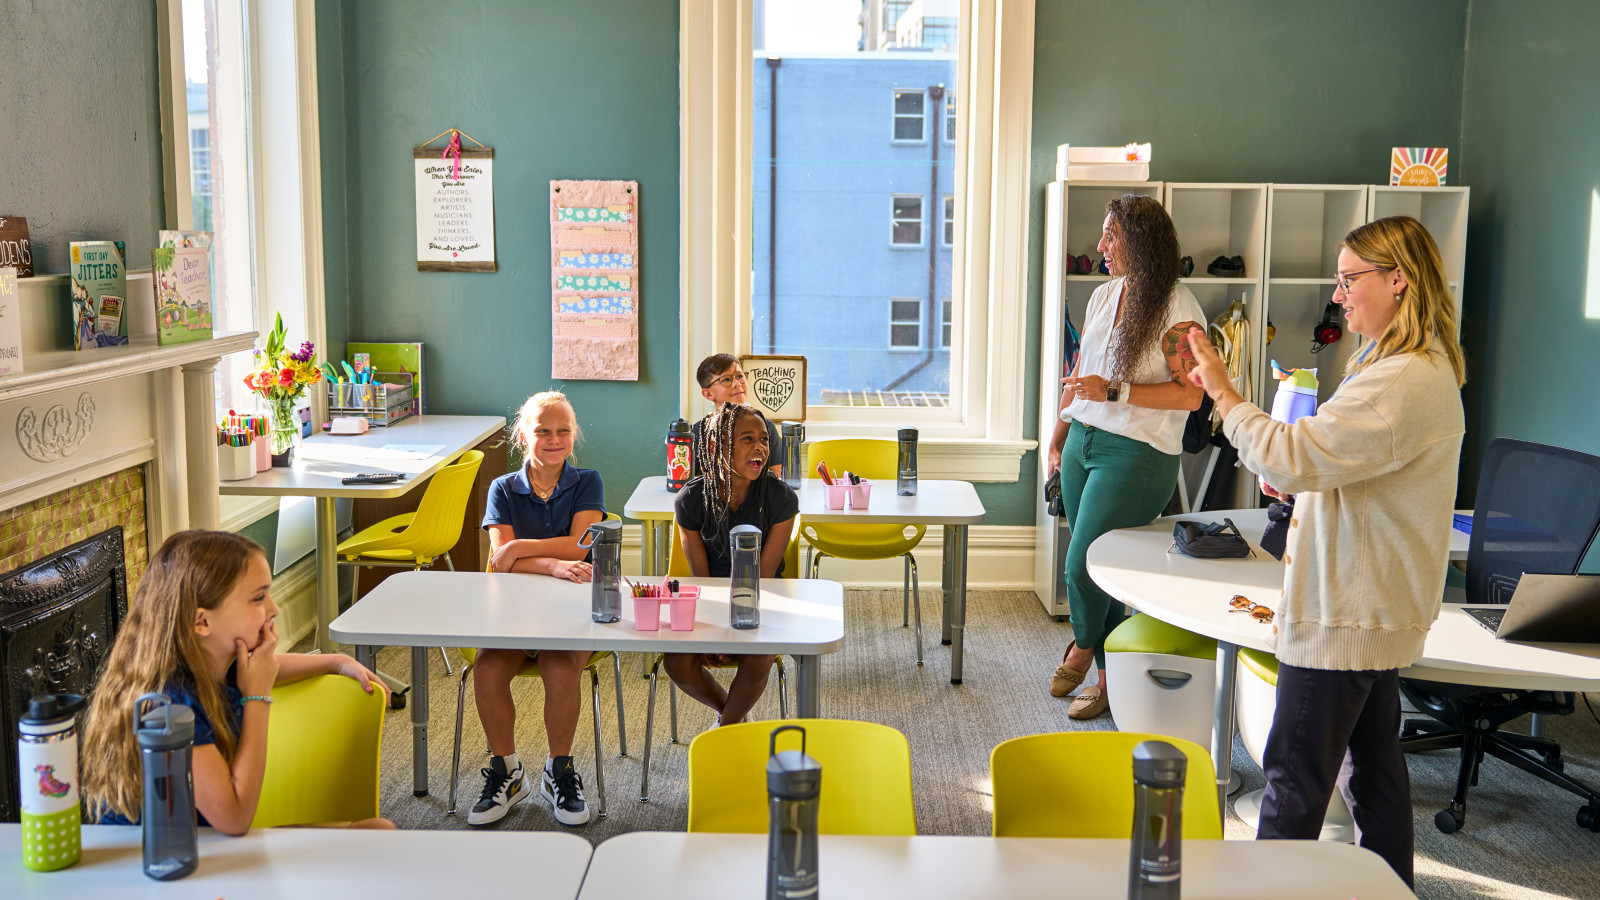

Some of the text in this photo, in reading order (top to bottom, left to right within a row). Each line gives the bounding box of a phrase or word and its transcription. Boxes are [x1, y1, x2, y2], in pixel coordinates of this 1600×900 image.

[423, 165, 483, 175] When Yu Enter
[428, 242, 441, 250] You
[84, 252, 98, 261] FIRST
[99, 252, 109, 261] DAY
[183, 257, 200, 271] Dear
[78, 264, 118, 281] JITTERS
[758, 382, 790, 396] HEART
[762, 396, 783, 408] WORK
